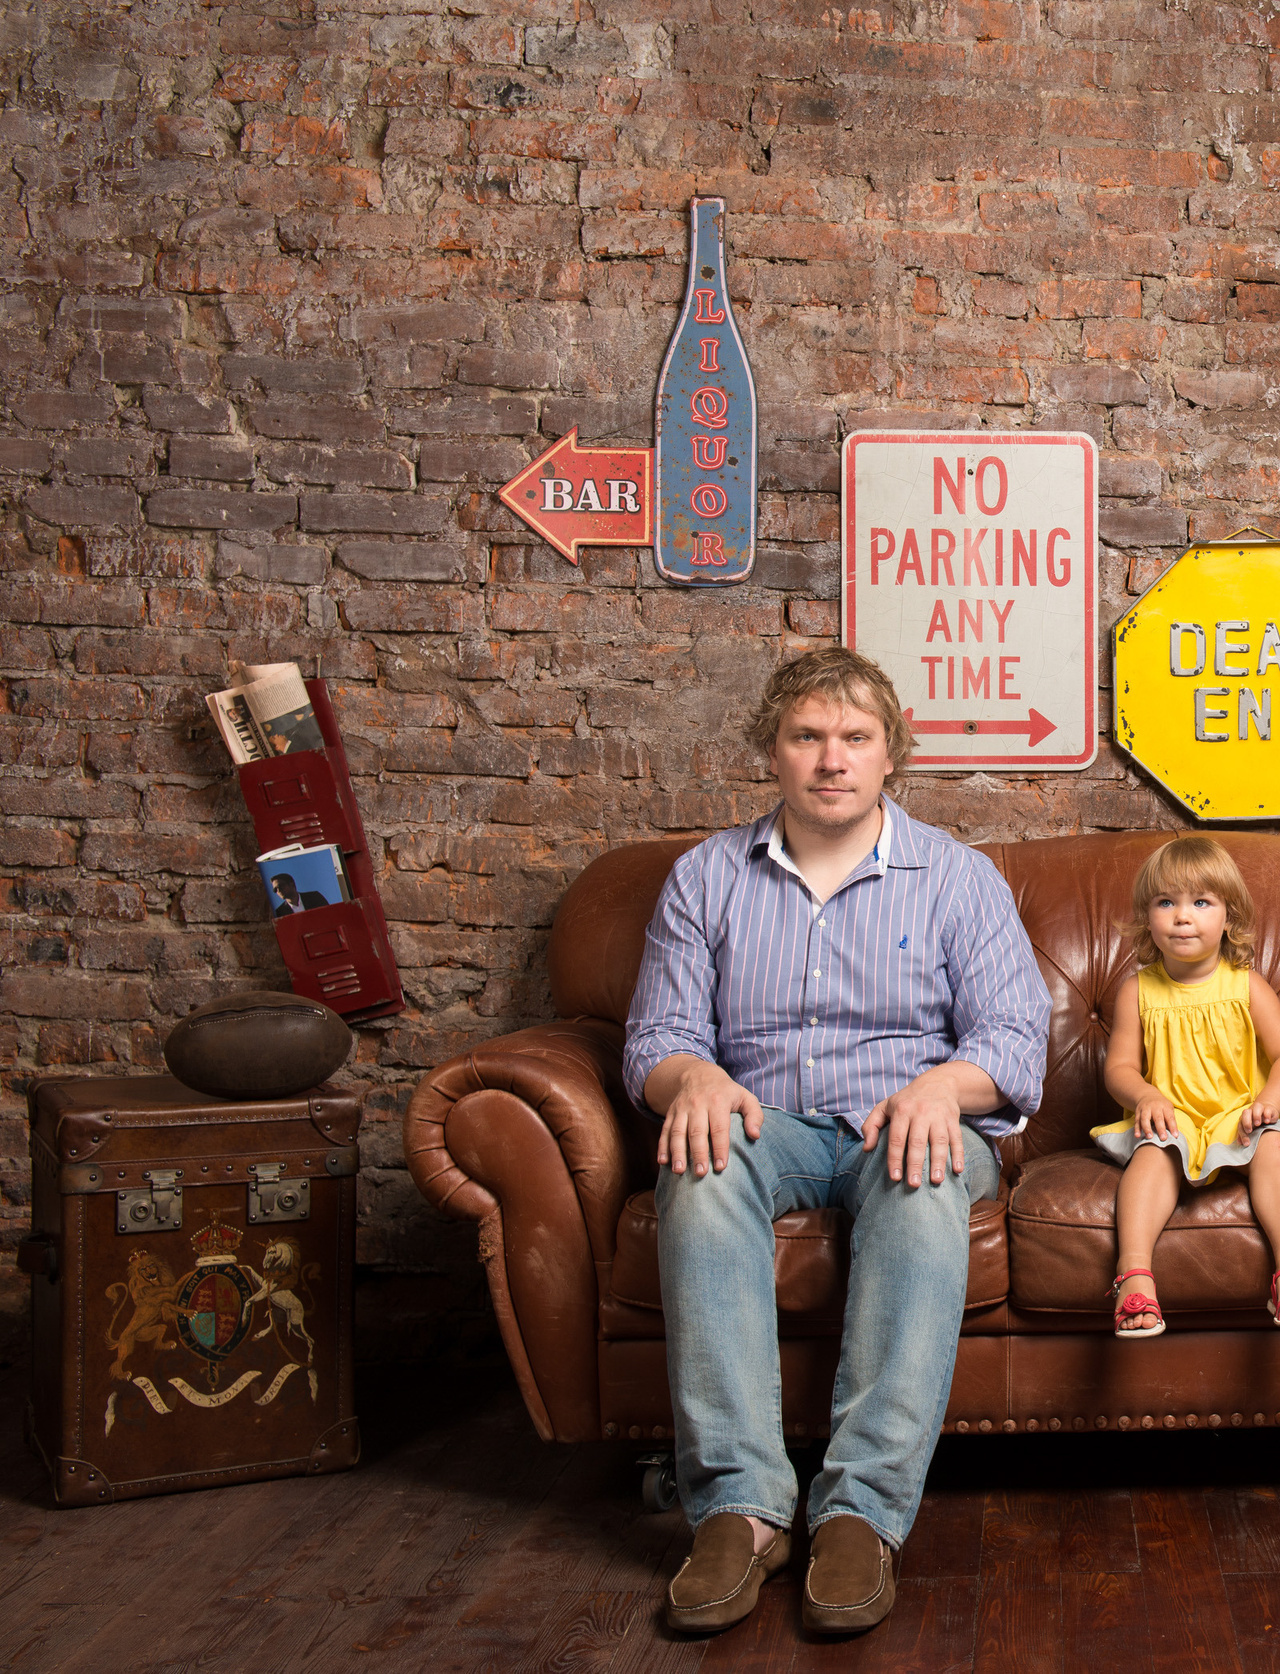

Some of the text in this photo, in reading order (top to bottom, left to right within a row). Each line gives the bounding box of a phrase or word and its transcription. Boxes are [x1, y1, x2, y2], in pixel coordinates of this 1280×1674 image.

[690, 289, 729, 568] LIQUOR
[540, 477, 641, 513] BAR
[933, 457, 1009, 516] NO
[869, 528, 1073, 587] PARKING
[926, 600, 1016, 644] ANY
[920, 656, 1022, 700] TIME
[201, 1266, 218, 1275] QUI
